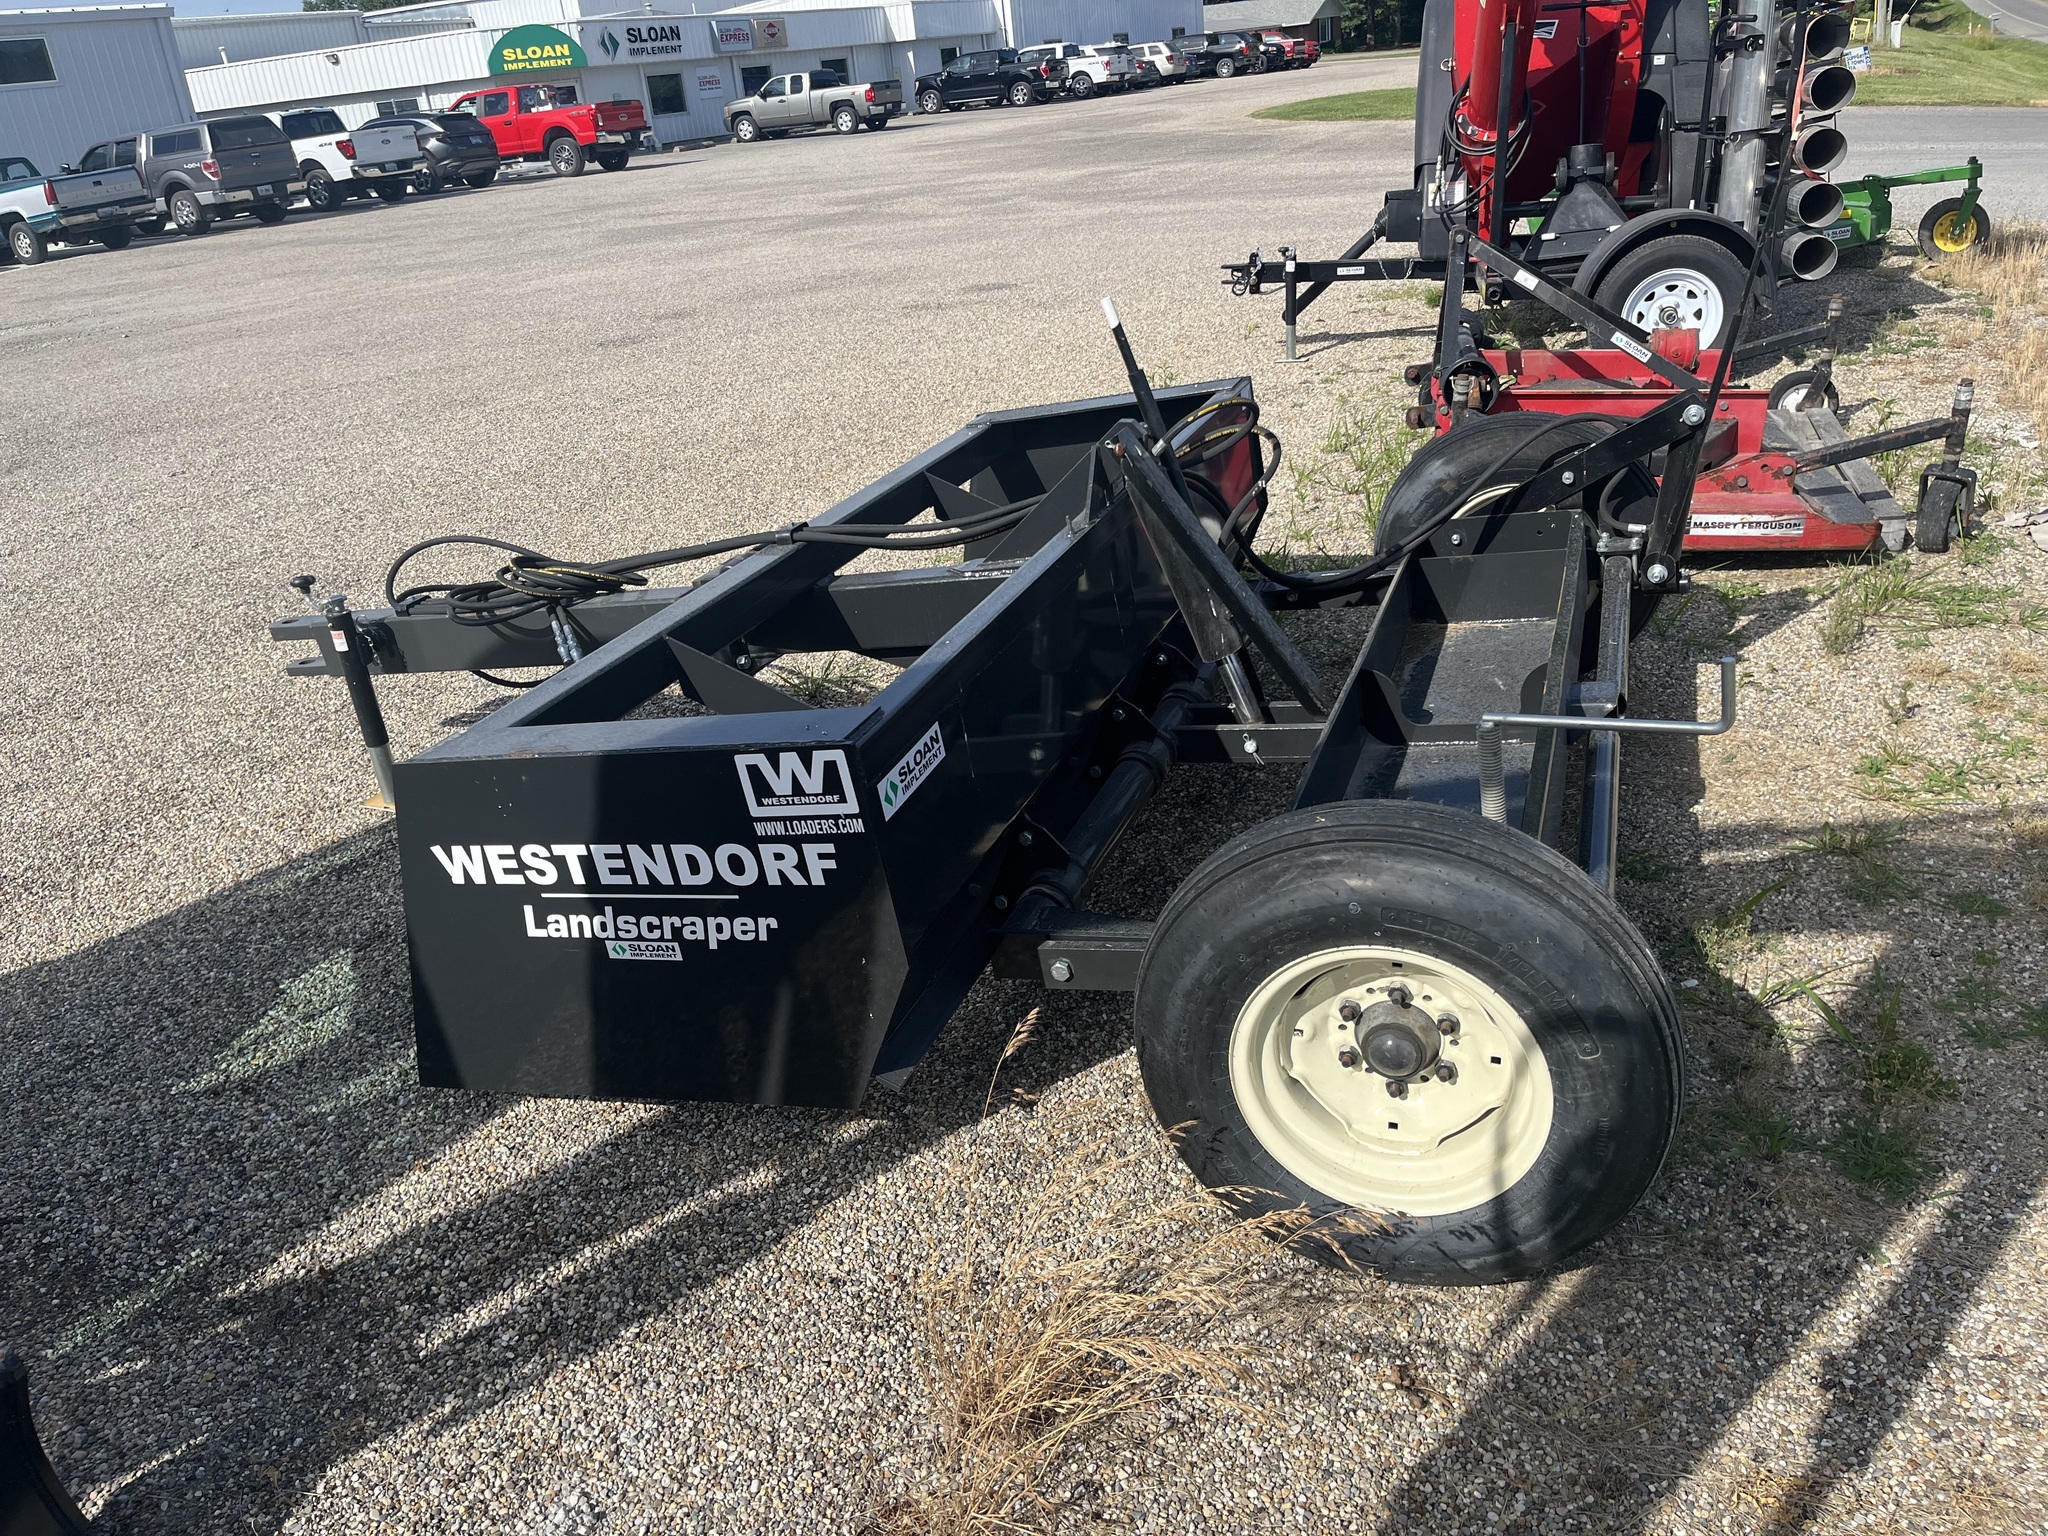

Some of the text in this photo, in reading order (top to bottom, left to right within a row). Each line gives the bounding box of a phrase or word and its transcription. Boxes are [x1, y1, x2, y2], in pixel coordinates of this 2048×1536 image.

[626, 25, 682, 44] SLOAN
[720, 32, 750, 43] EXPRESS
[502, 44, 571, 61] SLOAN
[629, 44, 683, 57] IMPLEMENT
[503, 58, 573, 71] IMPLEMENT
[699, 79, 721, 88] EXPRESS
[1624, 340, 1649, 358] SLOAN
[1693, 521, 1801, 530] MASSEY FERGUSON
[898, 729, 940, 784] SLOAN
[901, 745, 942, 796] IMPLEMENT
[761, 794, 841, 806] WESTENDORF
[753, 818, 866, 837] WWW.LOADERS.COM
[430, 843, 838, 887] WESTENDORF
[523, 904, 779, 950] Landscraper
[627, 943, 677, 953] SLOAN
